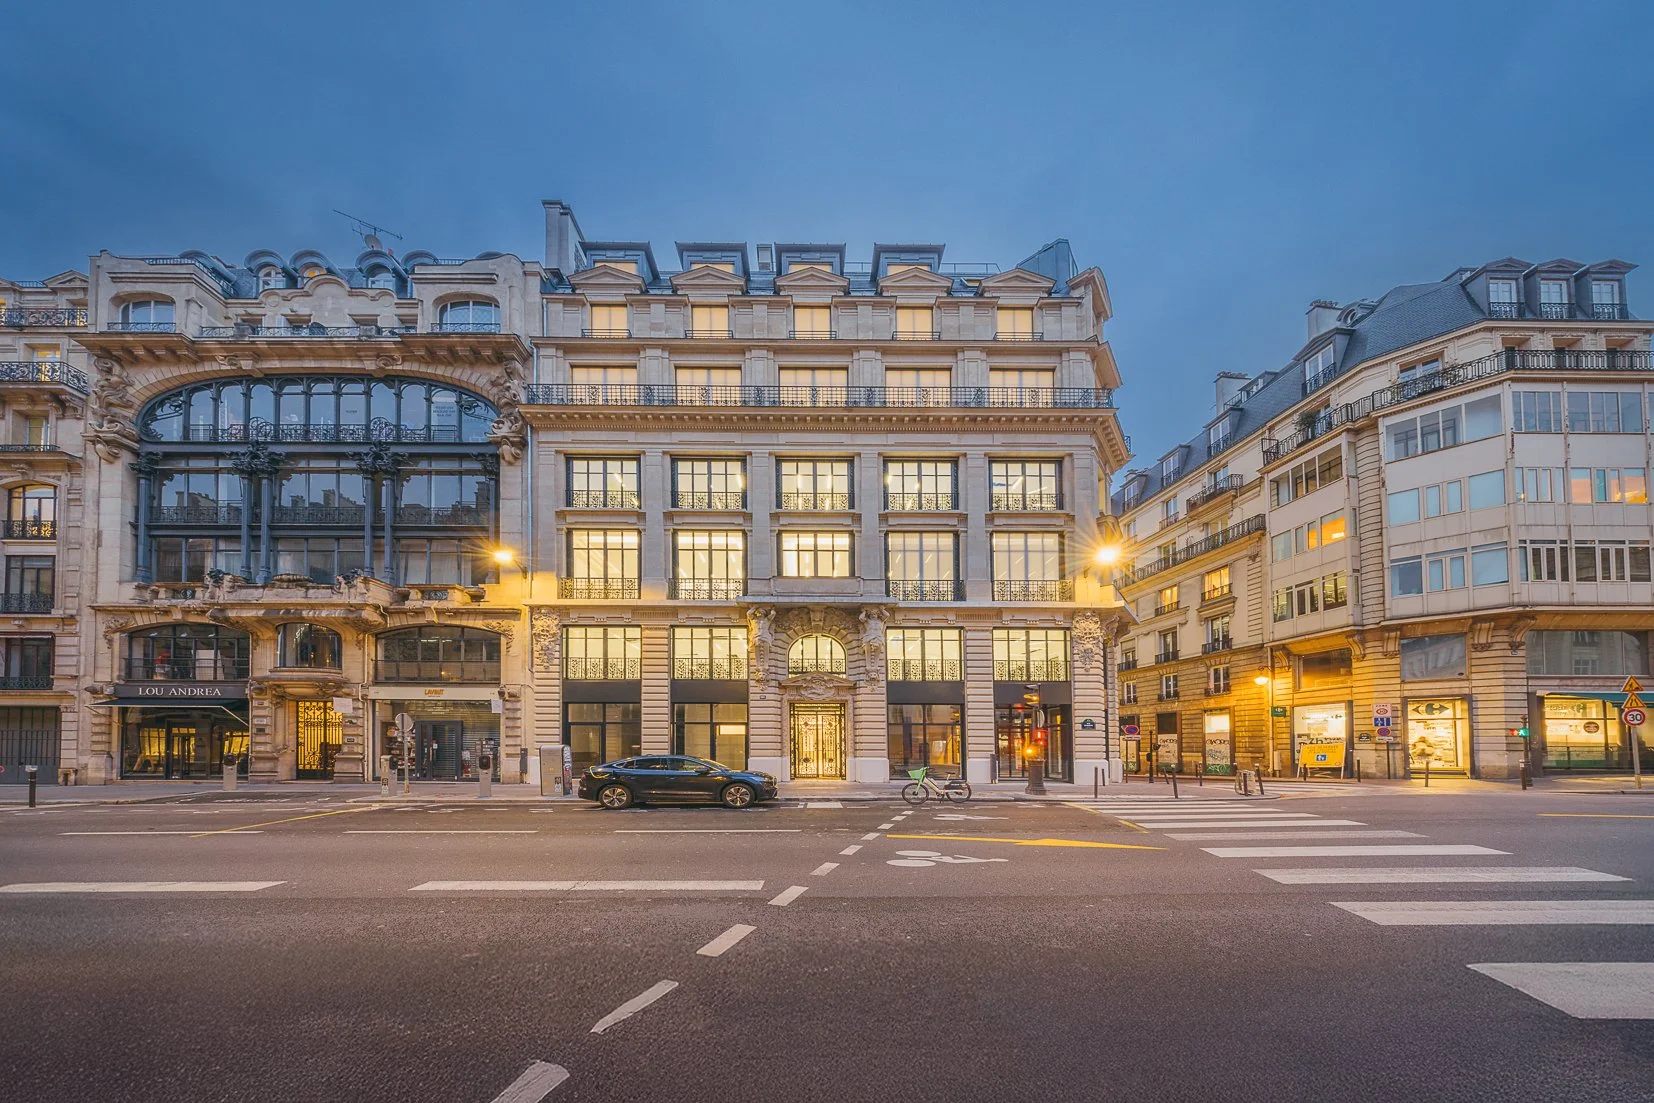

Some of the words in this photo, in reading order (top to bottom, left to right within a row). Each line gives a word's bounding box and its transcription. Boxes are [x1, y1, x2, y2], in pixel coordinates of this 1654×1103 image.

[138, 687, 164, 696] LOU
[168, 687, 222, 696] ANDREA
[1628, 713, 1642, 722] 30
